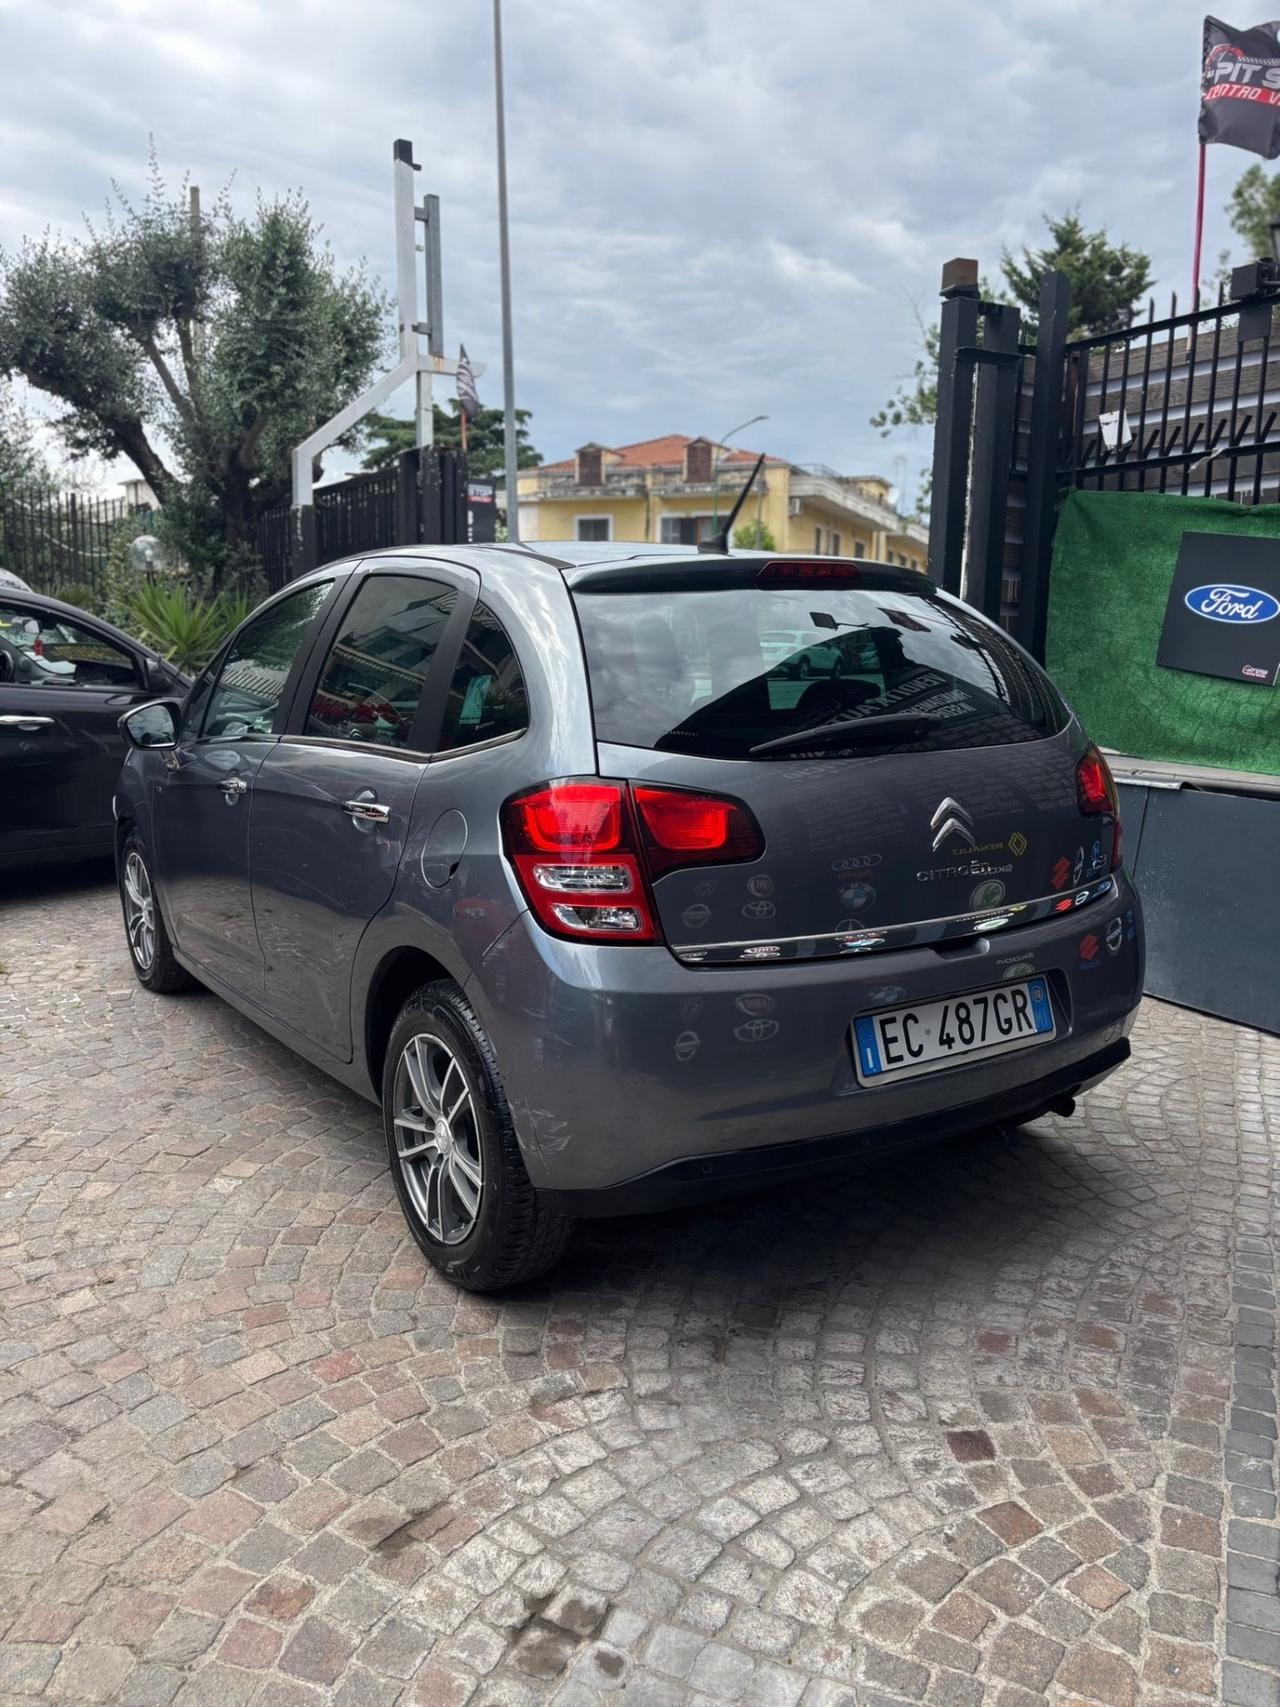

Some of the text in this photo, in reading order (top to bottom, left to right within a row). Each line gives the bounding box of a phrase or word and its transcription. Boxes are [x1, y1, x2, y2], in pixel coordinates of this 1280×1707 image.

[1214, 62, 1262, 84] PIT
[1201, 588, 1264, 619] Ford
[879, 988, 1033, 1065] EC 487GR
